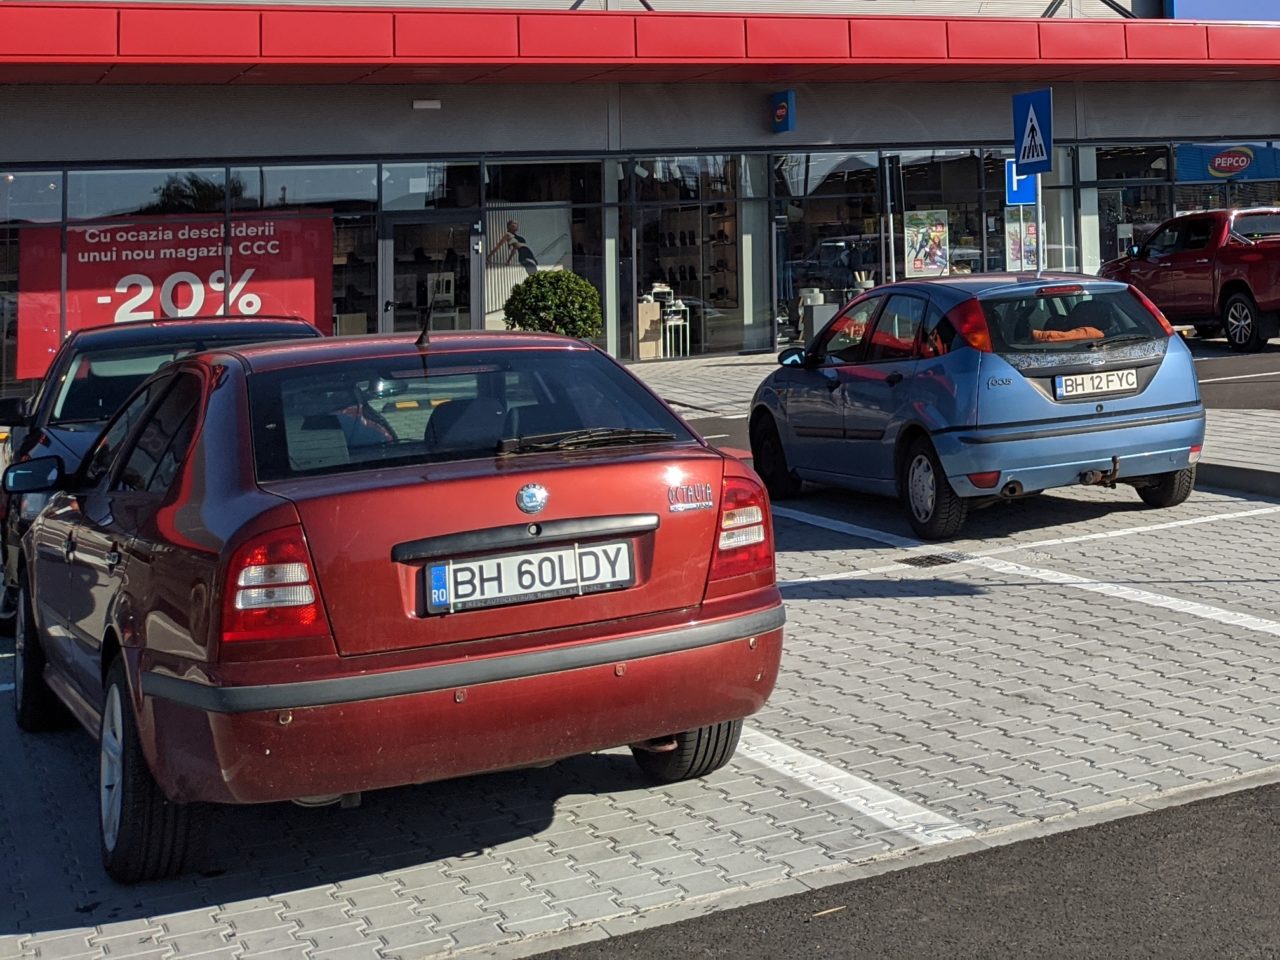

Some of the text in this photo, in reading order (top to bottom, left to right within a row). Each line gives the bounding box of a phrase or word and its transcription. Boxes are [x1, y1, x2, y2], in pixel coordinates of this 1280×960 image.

[1215, 157, 1247, 167] PEPCO
[85, 229, 111, 243] Cu
[116, 226, 173, 242] ocazia
[78, 247, 117, 263] unui
[122, 249, 155, 261] nou
[239, 241, 280, 255] CCC
[97, 268, 262, 323] -20%
[1064, 372, 1135, 393] BH 12 FYC
[453, 562, 504, 600] BH
[432, 588, 447, 604] RO
